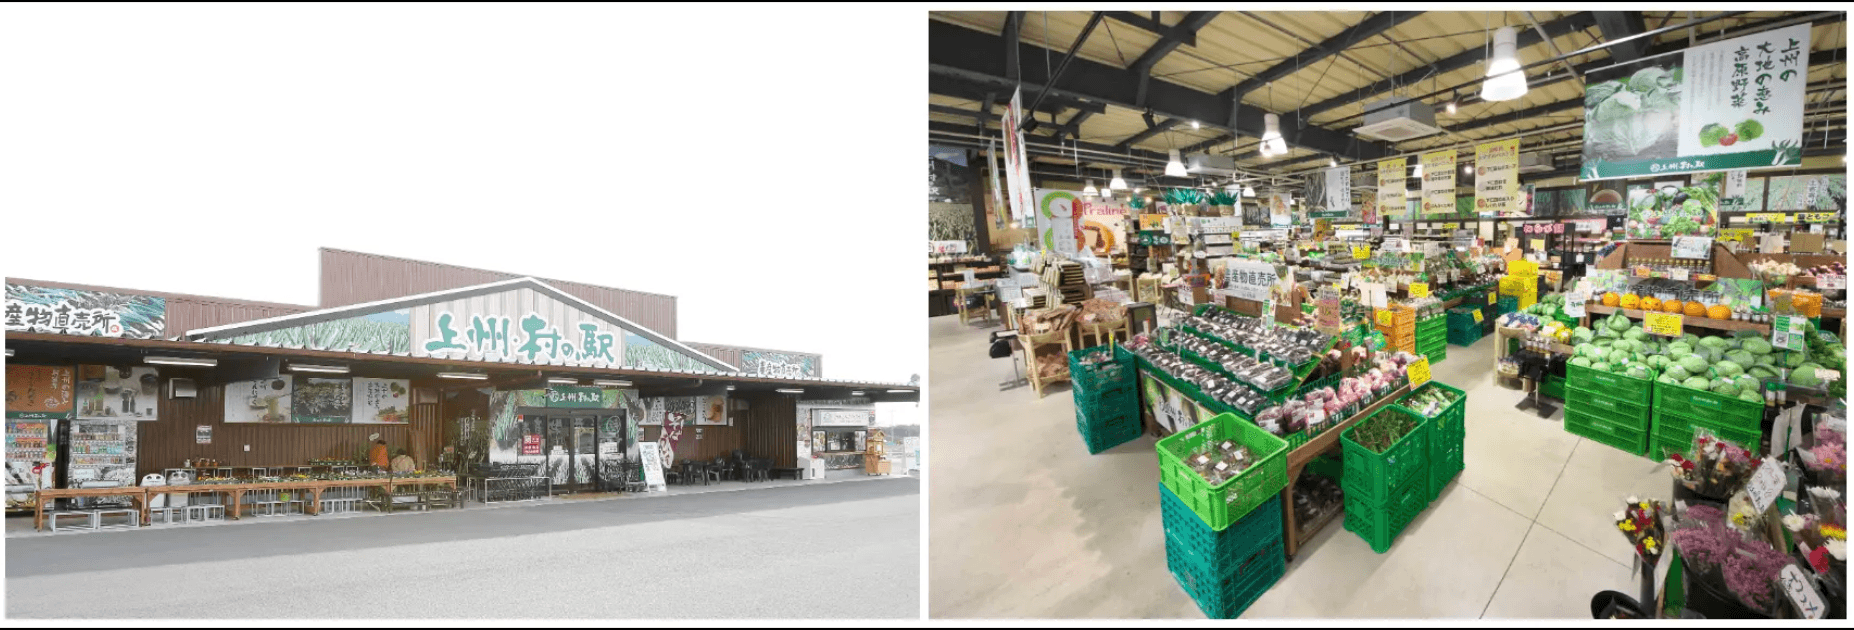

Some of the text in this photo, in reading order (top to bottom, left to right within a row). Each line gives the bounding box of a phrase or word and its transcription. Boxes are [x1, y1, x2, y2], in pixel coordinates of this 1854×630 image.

[1730, 45, 1750, 108] 高原野菜
[1752, 41, 1777, 115] 大地の恵み
[1779, 38, 1801, 82] 上州の
